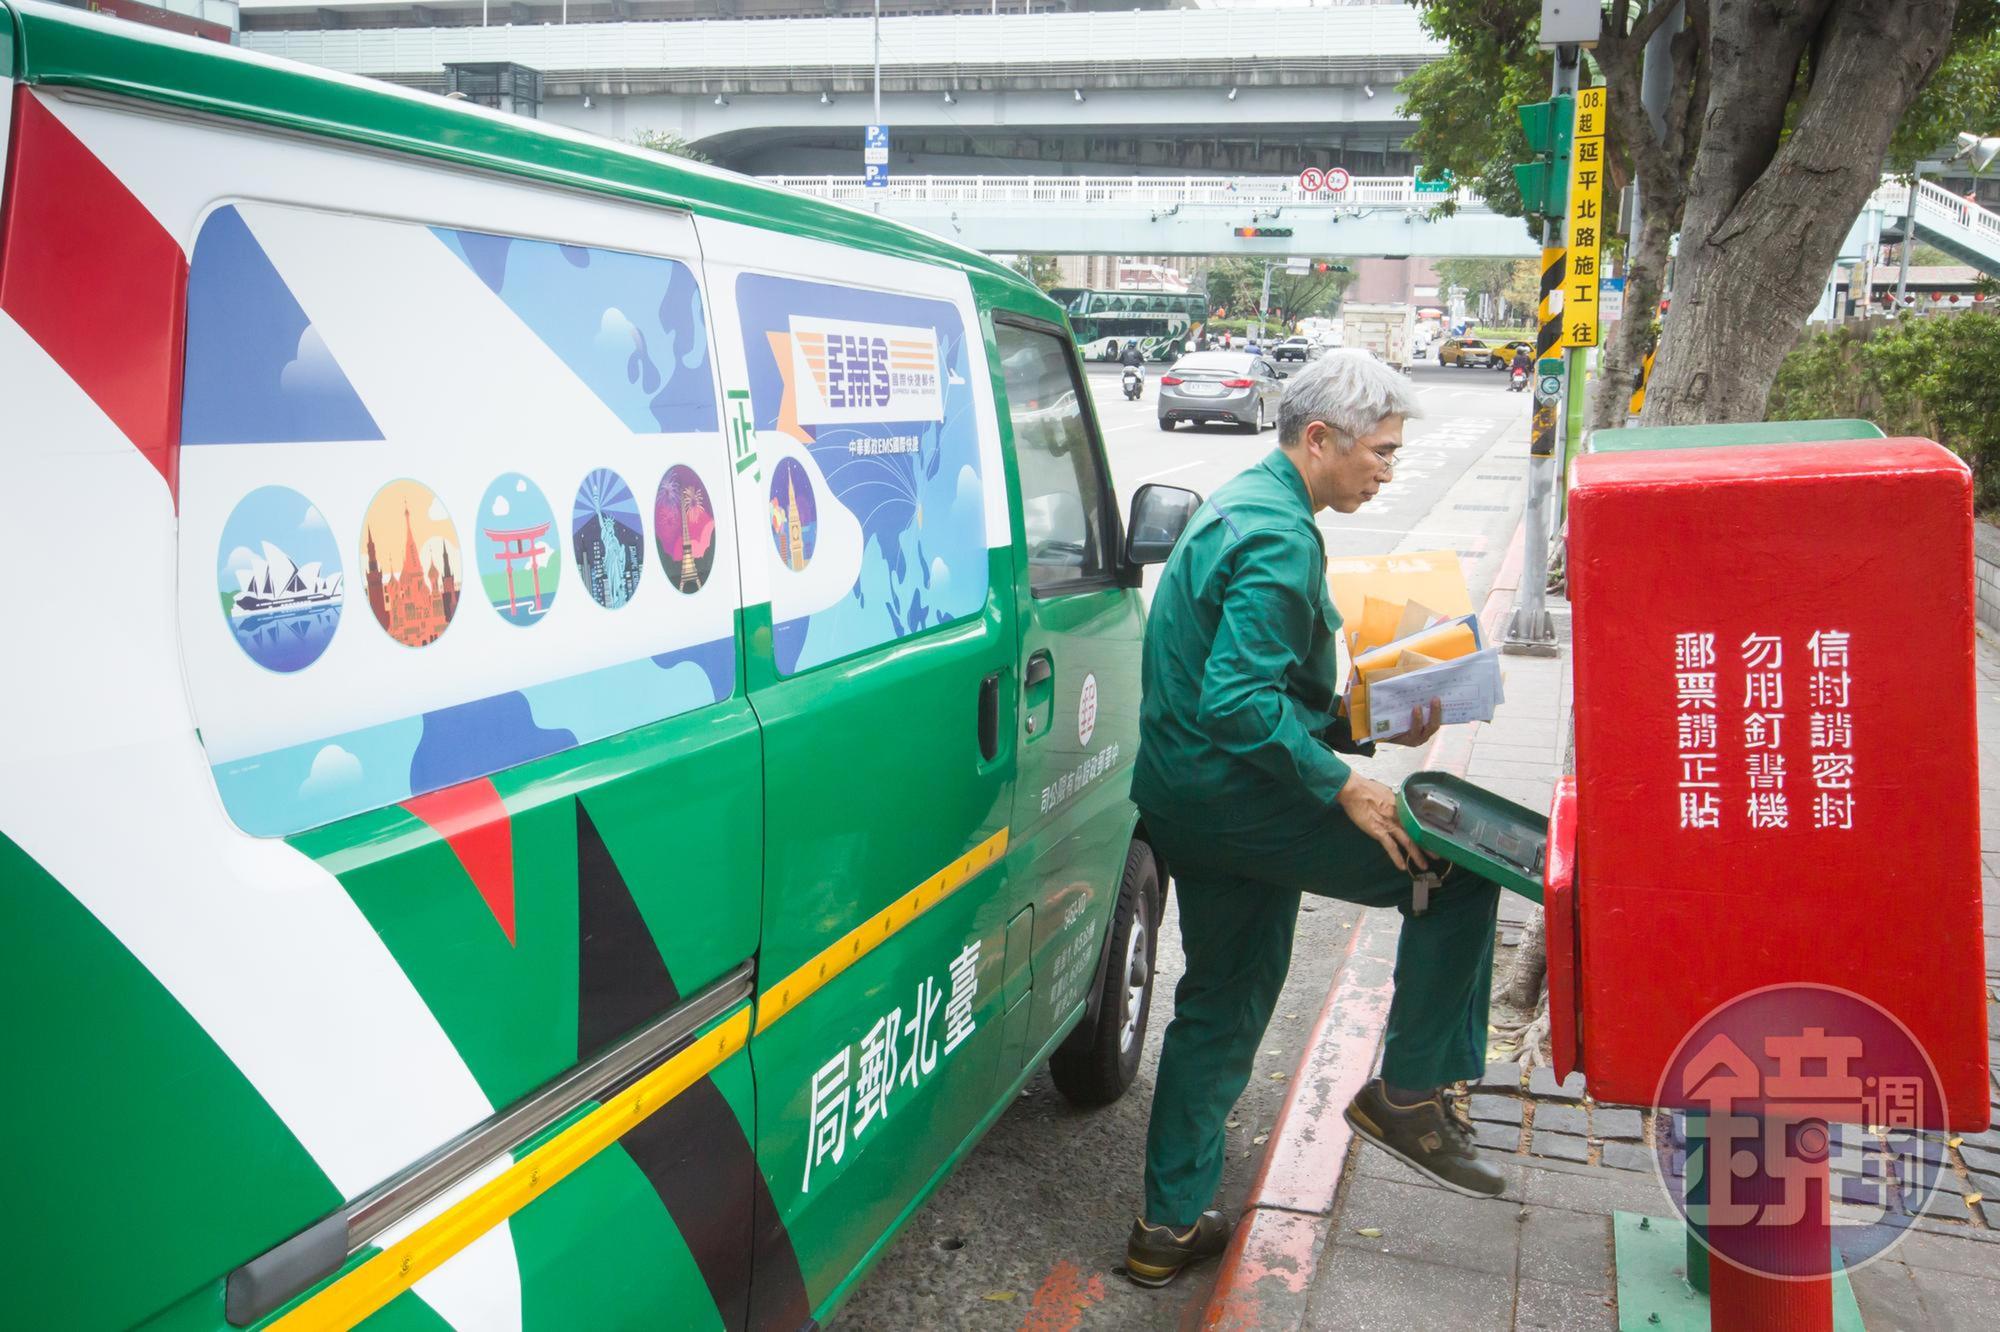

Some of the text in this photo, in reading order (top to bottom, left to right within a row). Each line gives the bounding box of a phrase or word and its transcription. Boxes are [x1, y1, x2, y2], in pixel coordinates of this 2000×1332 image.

[868, 126, 880, 141] P
[1579, 113, 1592, 132] 起
[866, 166, 879, 181] P
[827, 334, 890, 408] EMS
[892, 373, 935, 386] 國際快捷郵件
[1675, 632, 1721, 830] 郵票請正貼
[1741, 632, 1789, 830] 勿用釘書機
[1807, 629, 1856, 831] 信封請密封
